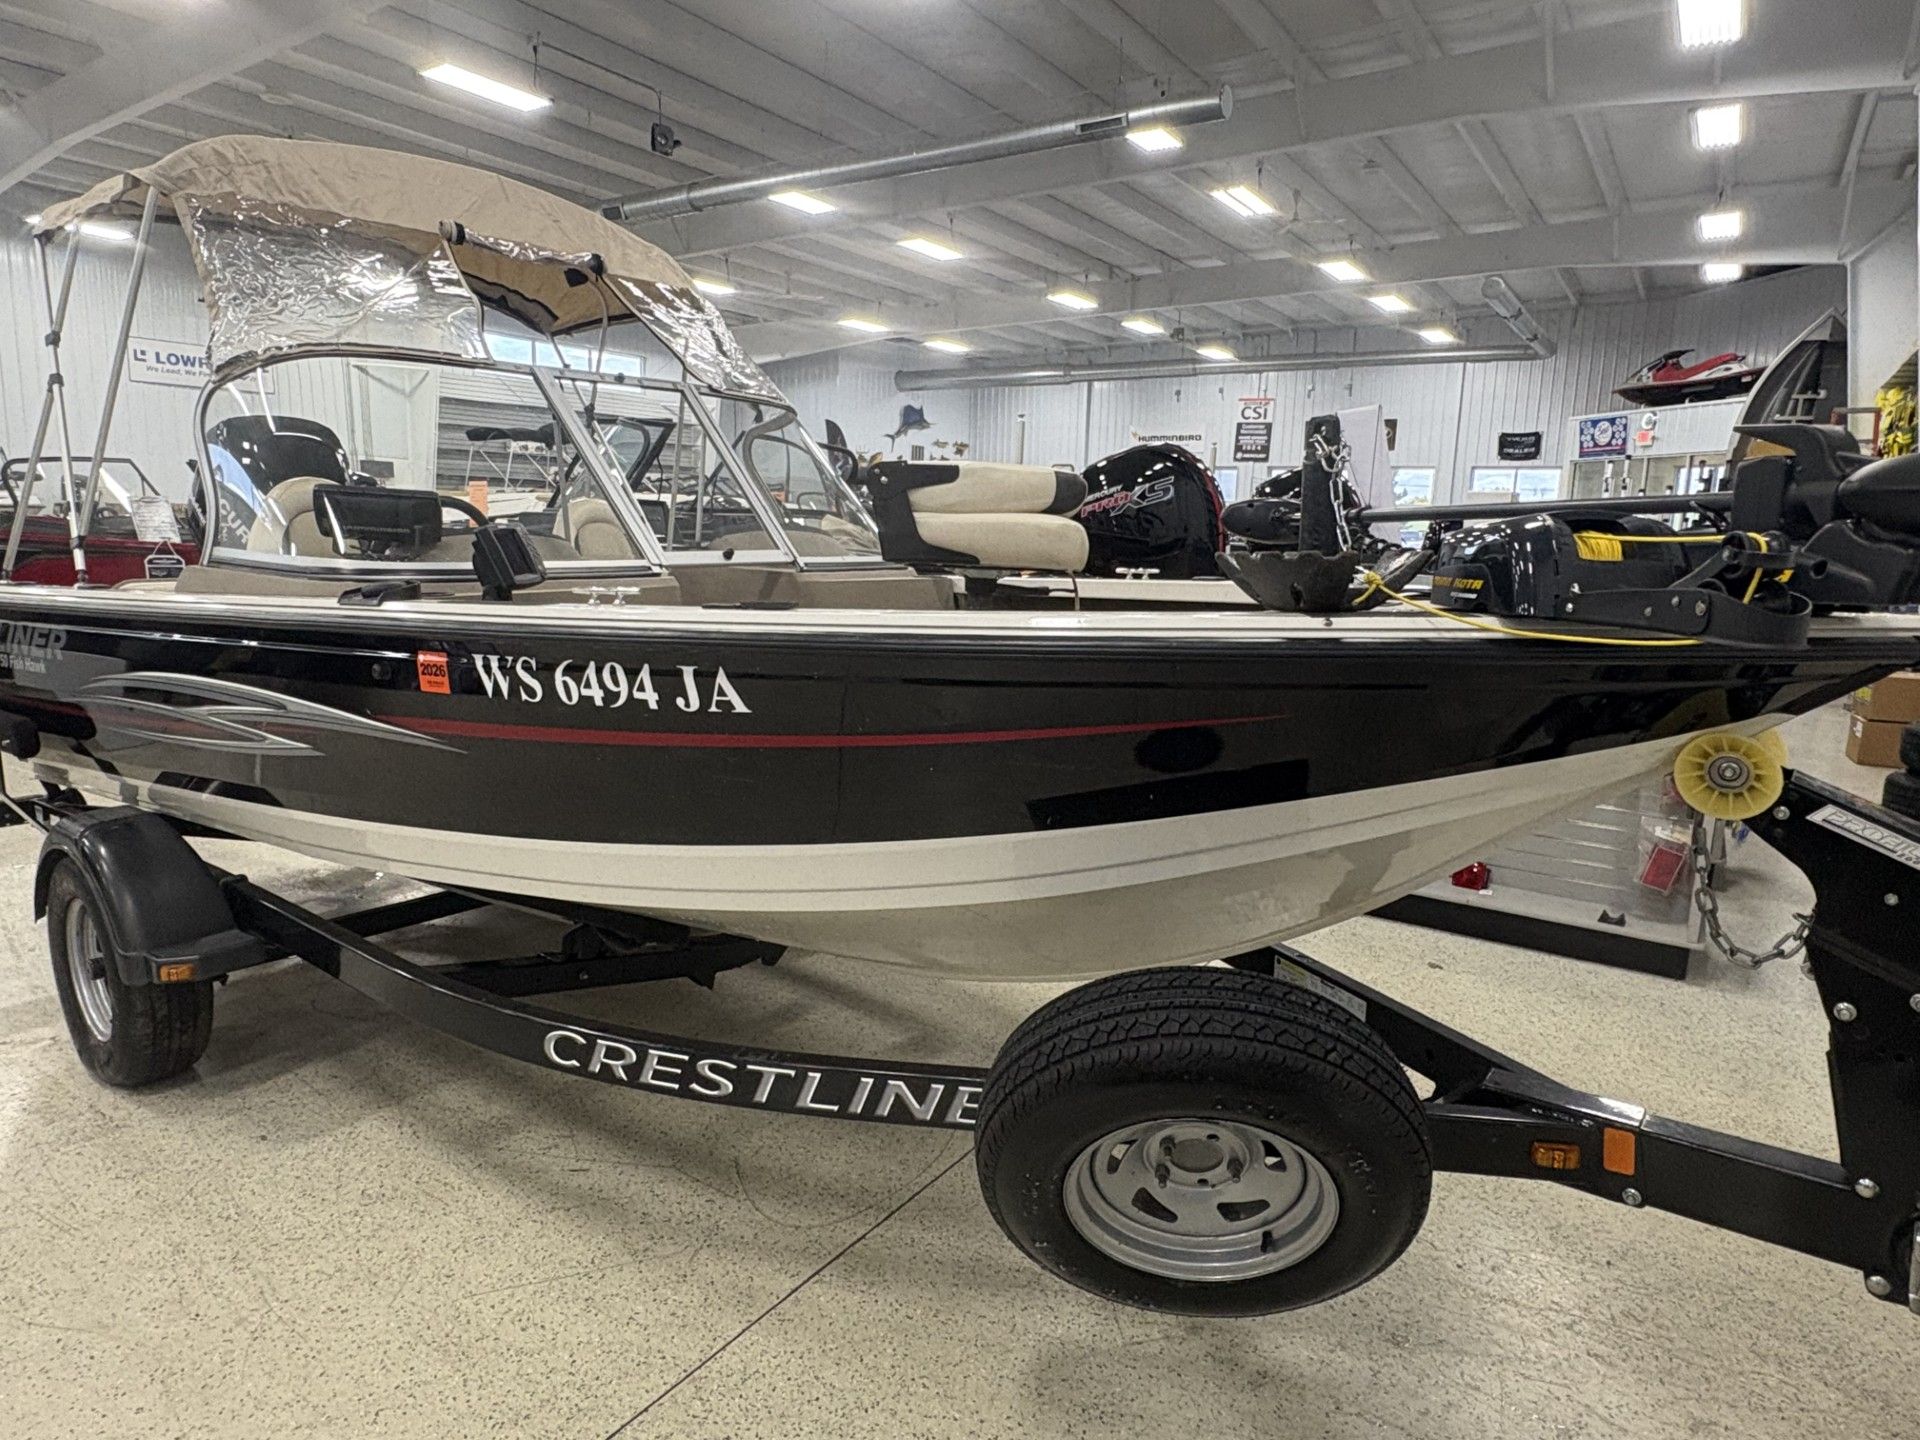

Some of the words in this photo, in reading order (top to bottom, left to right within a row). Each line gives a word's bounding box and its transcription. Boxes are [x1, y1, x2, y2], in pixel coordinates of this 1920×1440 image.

[1241, 406, 1268, 420] CSI
[1453, 578, 1484, 590] KOTA
[0, 622, 67, 661] INER
[420, 663, 446, 677] 2026
[471, 653, 543, 703] WS
[554, 659, 660, 710] 6494
[675, 664, 753, 714] JA
